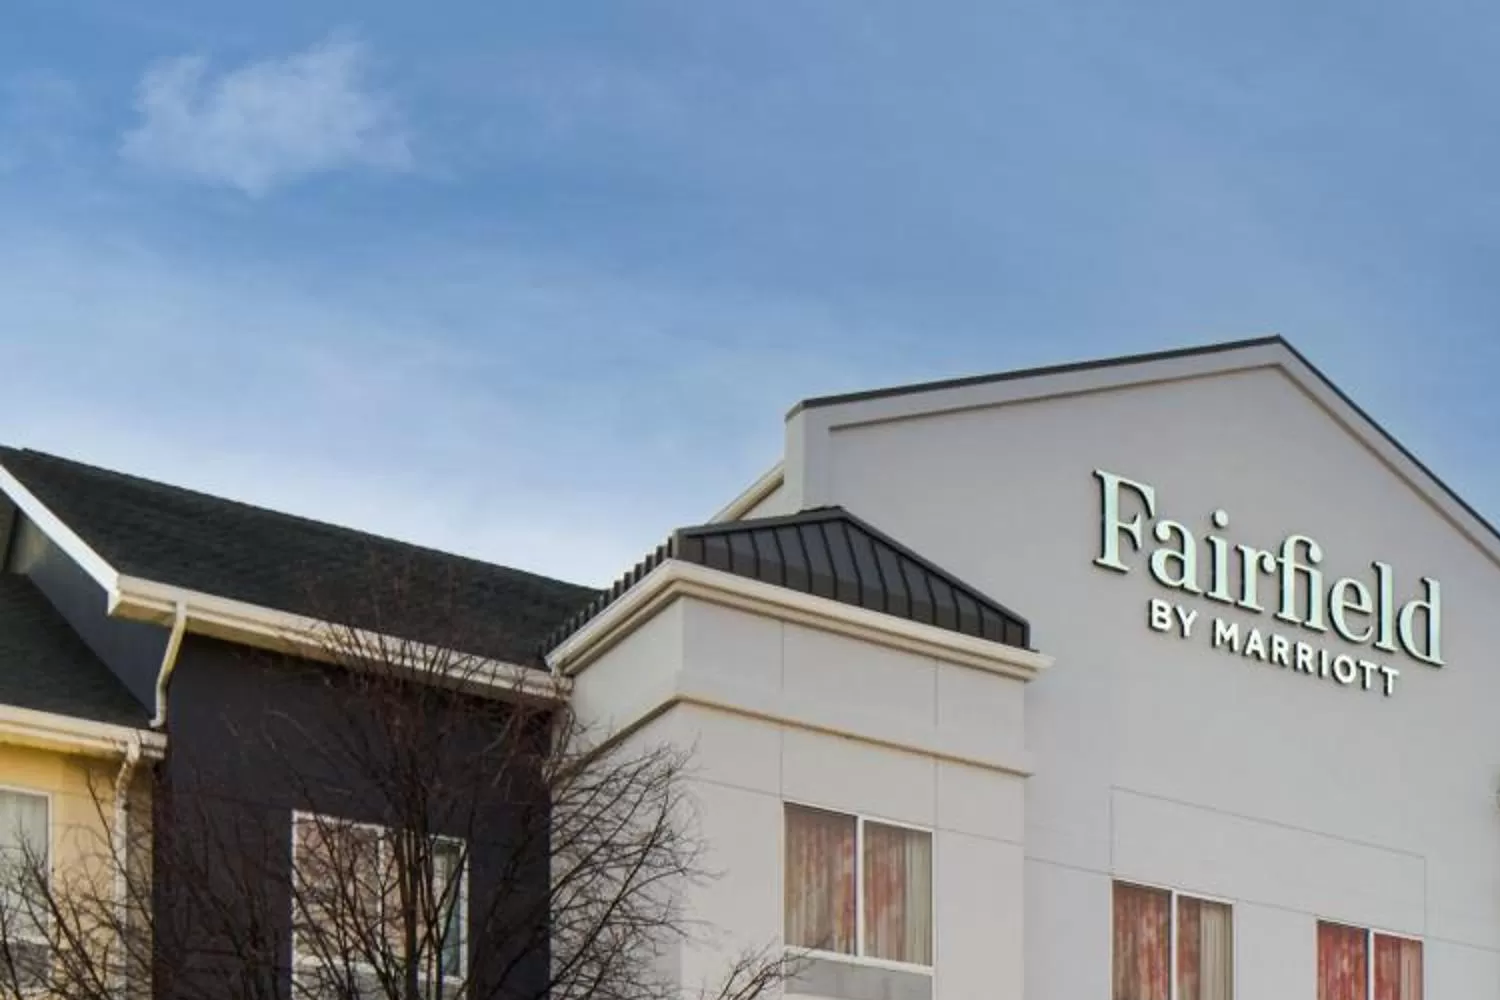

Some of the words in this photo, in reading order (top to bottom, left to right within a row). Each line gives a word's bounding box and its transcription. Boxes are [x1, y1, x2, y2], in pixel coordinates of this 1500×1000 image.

[1093, 468, 1445, 666] Fairfield
[1149, 597, 1197, 637] BY
[1213, 619, 1399, 696] MARRIOTT
